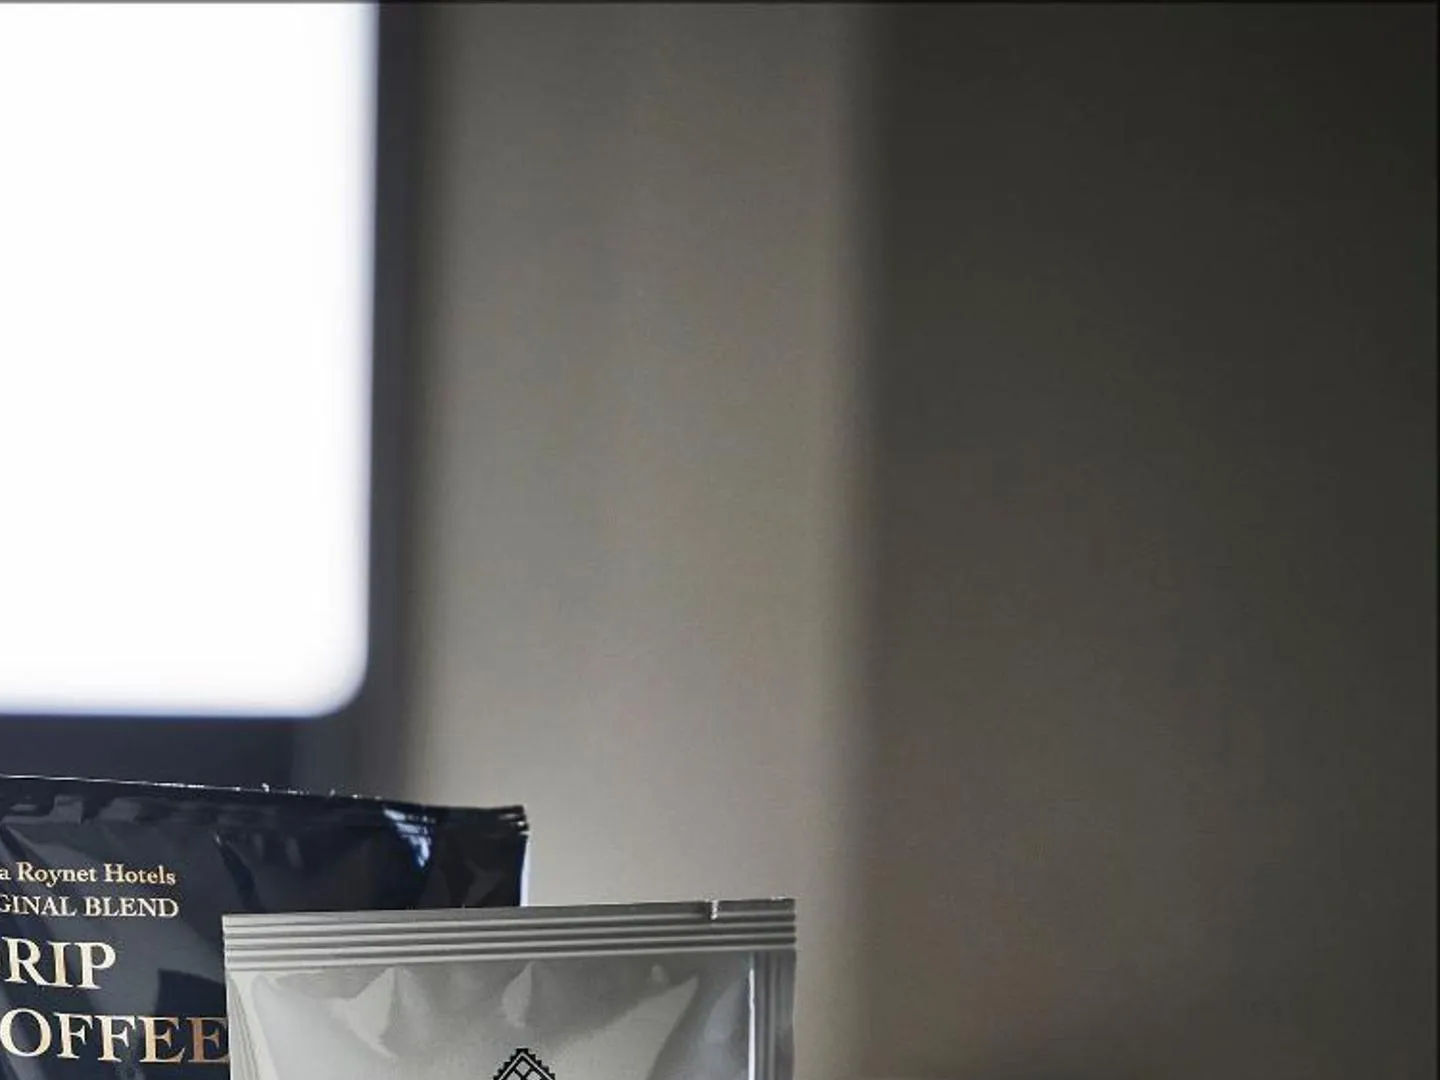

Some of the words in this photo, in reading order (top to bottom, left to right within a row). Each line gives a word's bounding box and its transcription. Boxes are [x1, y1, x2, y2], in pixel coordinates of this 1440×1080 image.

[16, 861, 97, 887] Roynet
[104, 863, 176, 886] Hotels
[84, 896, 179, 918] BLEND
